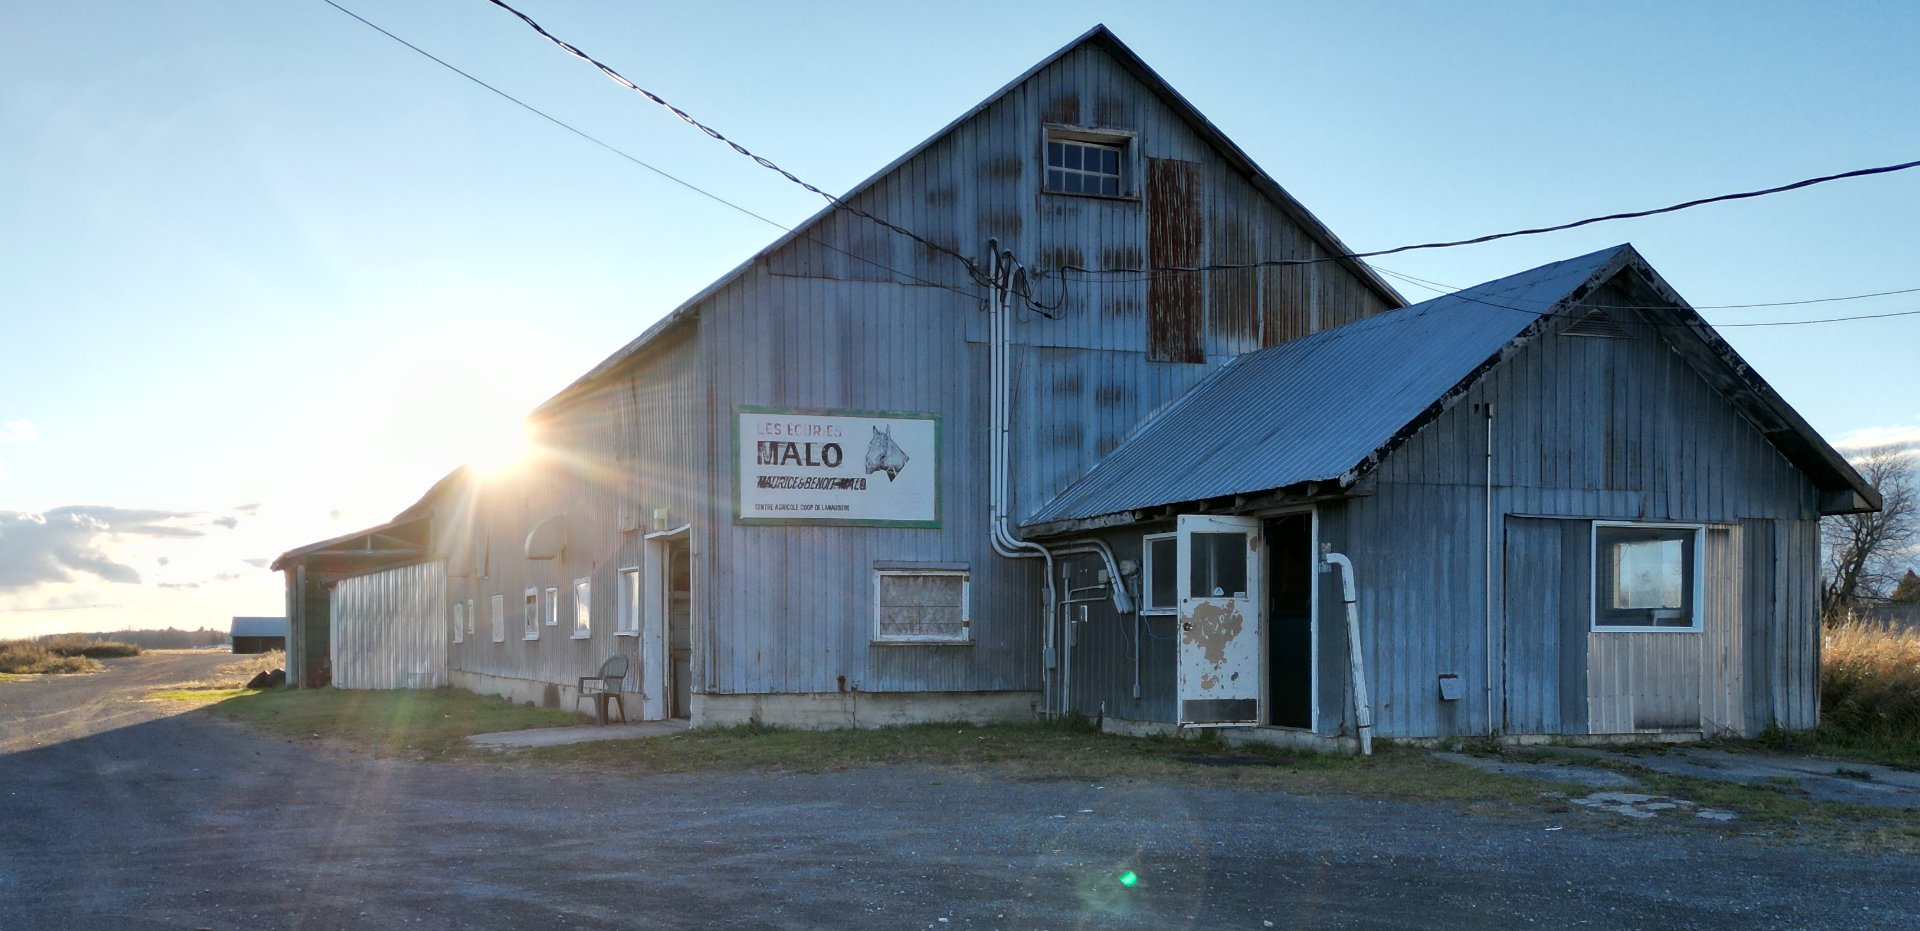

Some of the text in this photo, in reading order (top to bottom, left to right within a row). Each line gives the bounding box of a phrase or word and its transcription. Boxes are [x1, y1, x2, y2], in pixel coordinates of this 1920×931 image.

[757, 423, 842, 438] LES ÉCURES
[757, 440, 843, 468] MALO
[754, 503, 774, 511] CENTRE
[774, 503, 799, 511] AGRICOLE
[800, 504, 814, 512] COOP
[814, 504, 821, 512] DE
